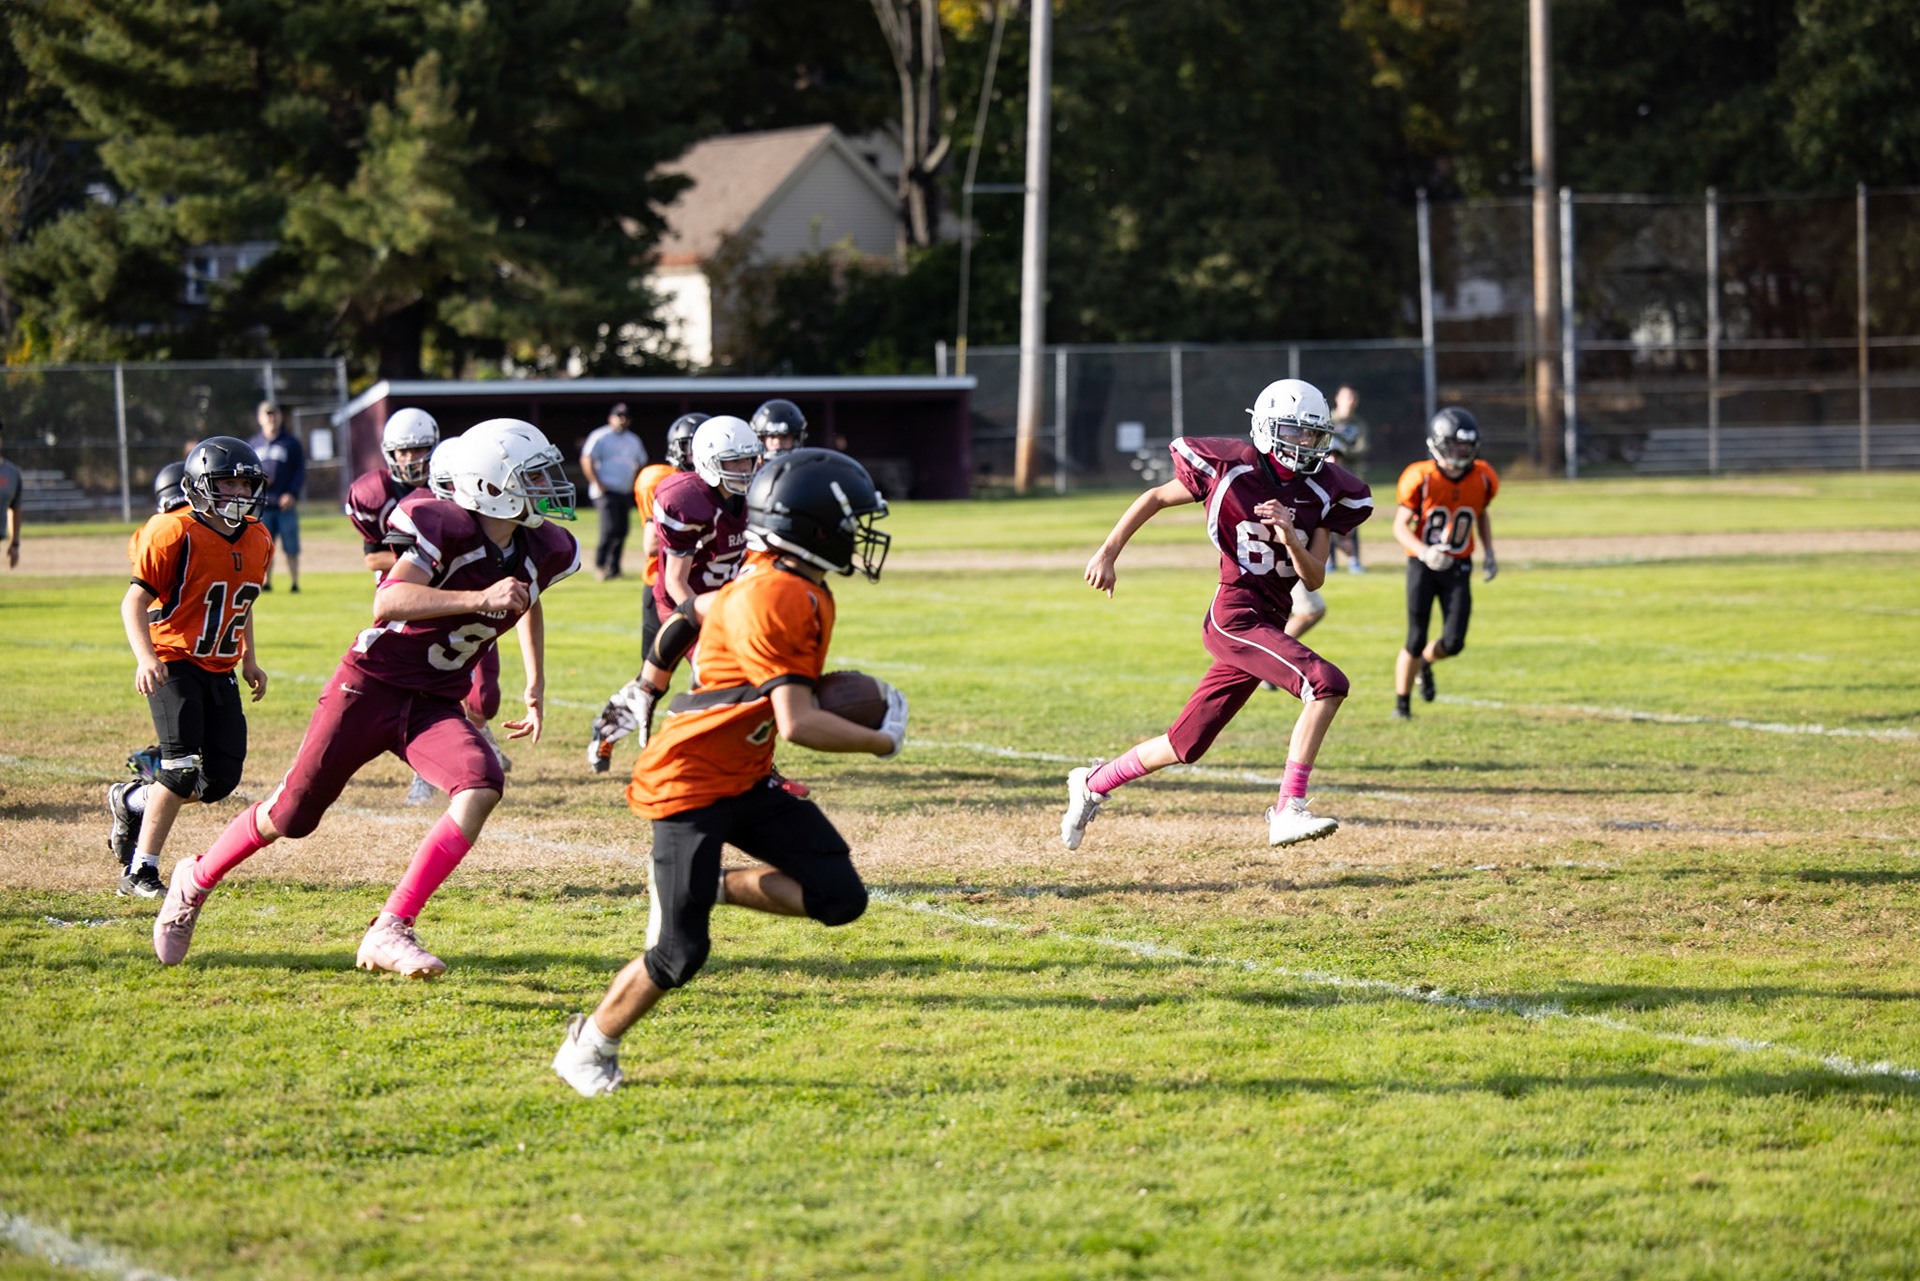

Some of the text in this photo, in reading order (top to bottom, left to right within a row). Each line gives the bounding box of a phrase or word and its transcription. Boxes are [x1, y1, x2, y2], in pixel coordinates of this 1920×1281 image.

[728, 532, 745, 548] RA
[1235, 520, 1309, 578] 63
[1421, 505, 1477, 554] 80
[231, 552, 242, 572] U
[193, 581, 262, 658] 12
[427, 622, 497, 671] 9
